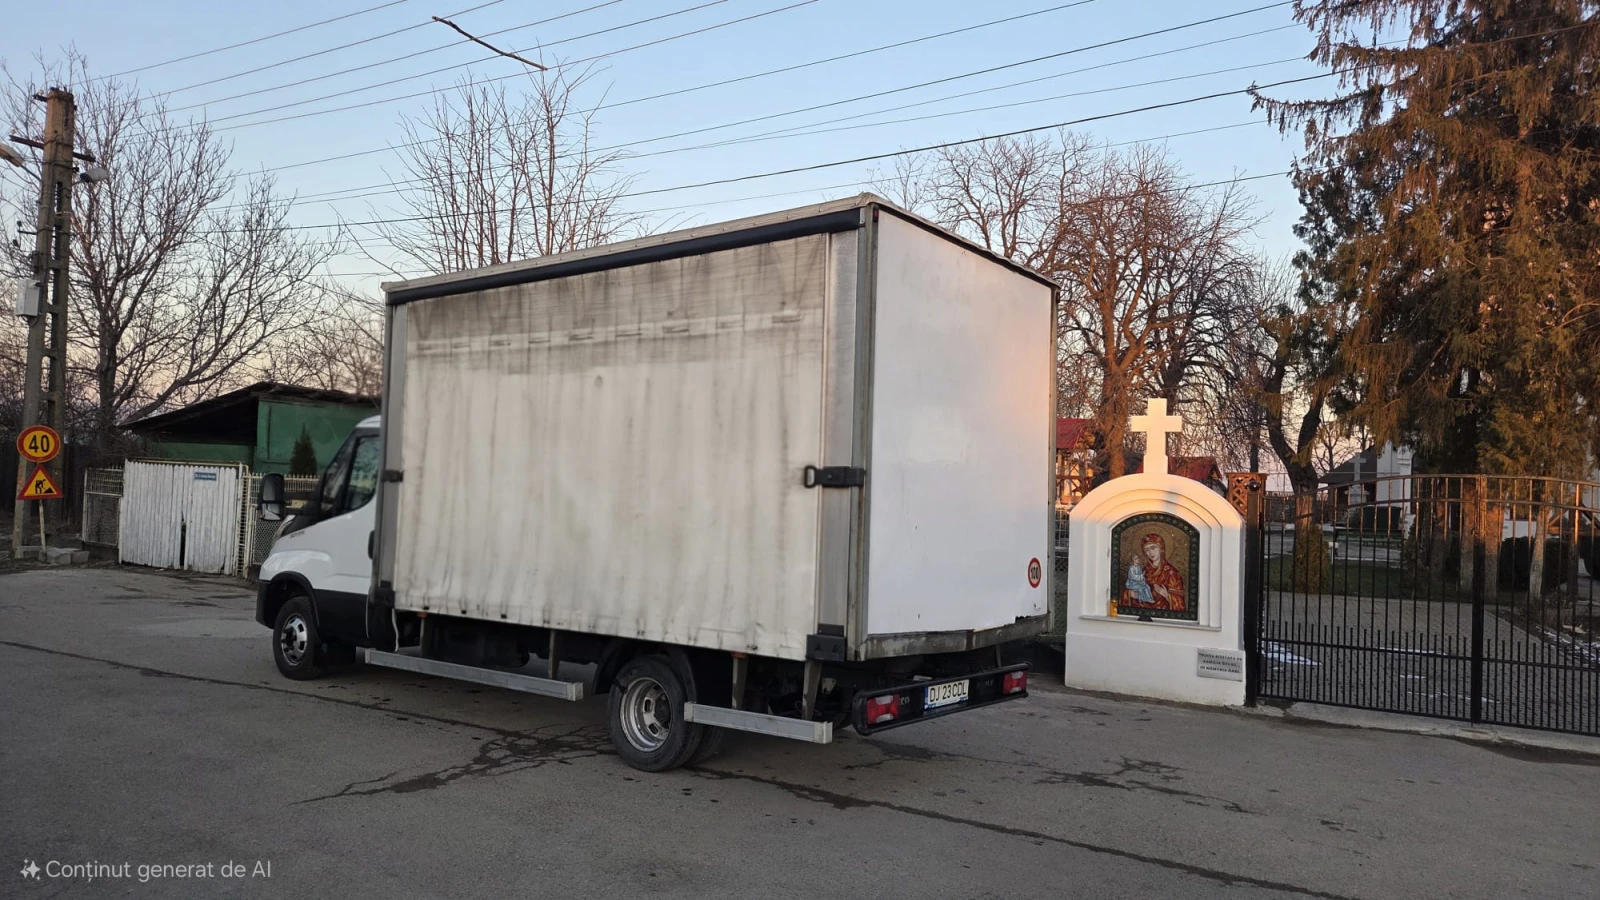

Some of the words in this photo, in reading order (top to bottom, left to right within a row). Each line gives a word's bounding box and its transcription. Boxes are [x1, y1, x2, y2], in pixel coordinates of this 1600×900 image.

[28, 434, 50, 453] 40
[930, 686, 940, 702] DJ
[942, 684, 951, 700] 23
[952, 681, 966, 697] CDL
